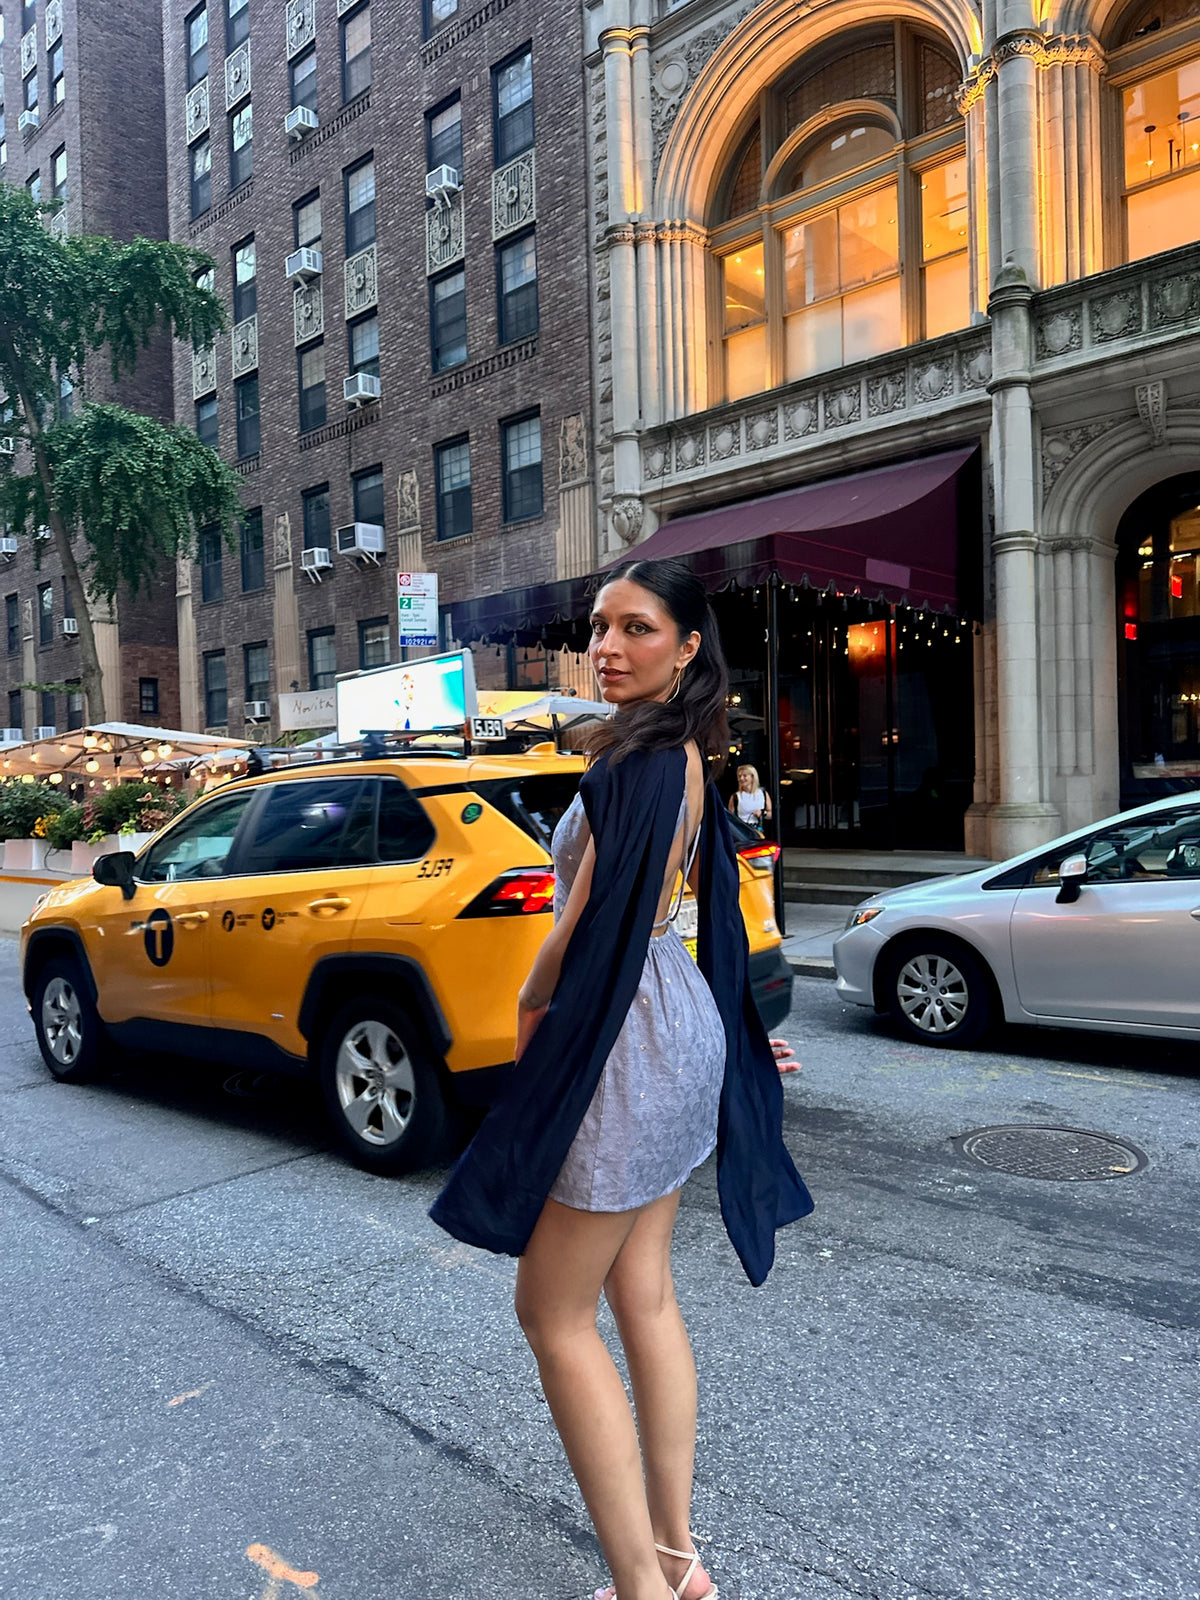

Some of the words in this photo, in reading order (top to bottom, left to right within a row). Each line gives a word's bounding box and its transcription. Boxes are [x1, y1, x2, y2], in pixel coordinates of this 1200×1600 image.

[583, 575, 605, 597] 28
[402, 598, 409, 608] 2
[475, 720, 503, 737] 5J39
[150, 919, 169, 959] T
